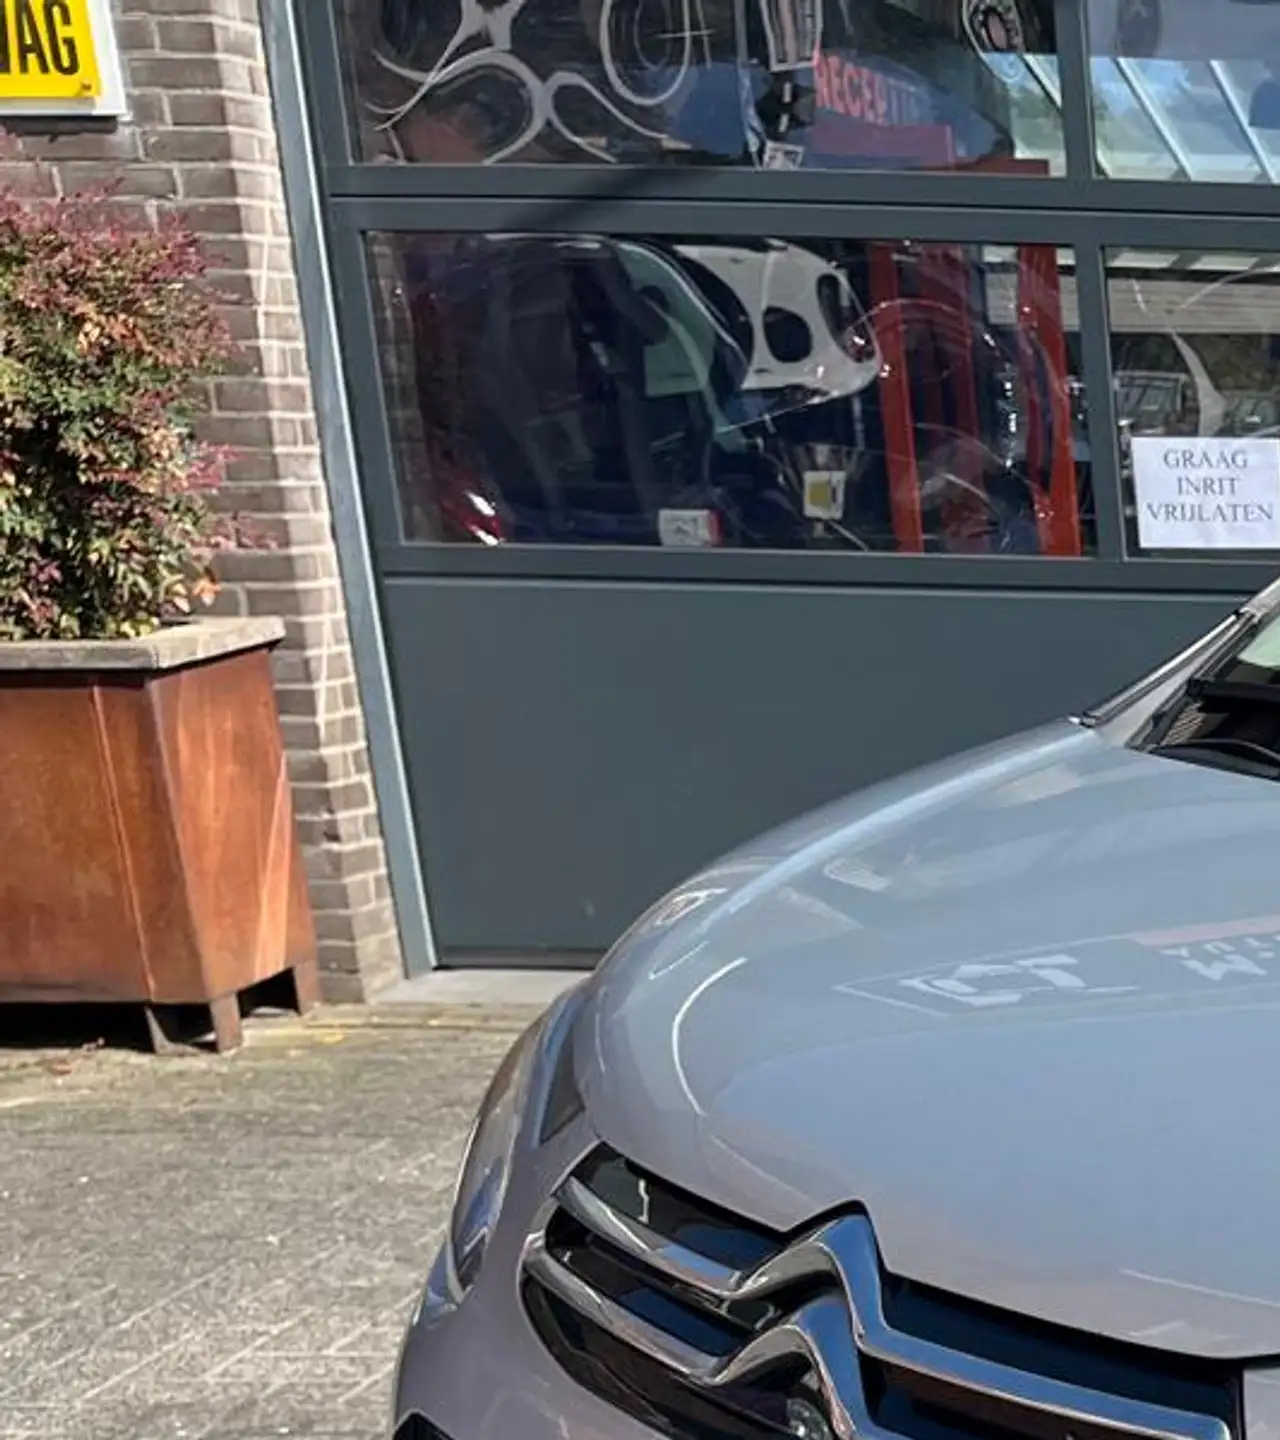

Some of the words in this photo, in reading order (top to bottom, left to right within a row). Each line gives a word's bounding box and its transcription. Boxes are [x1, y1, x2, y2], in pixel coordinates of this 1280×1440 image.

[1163, 448, 1248, 469] GRAAG
[1177, 475, 1240, 496] INRIT
[1147, 502, 1273, 522] VRIJLATEN
